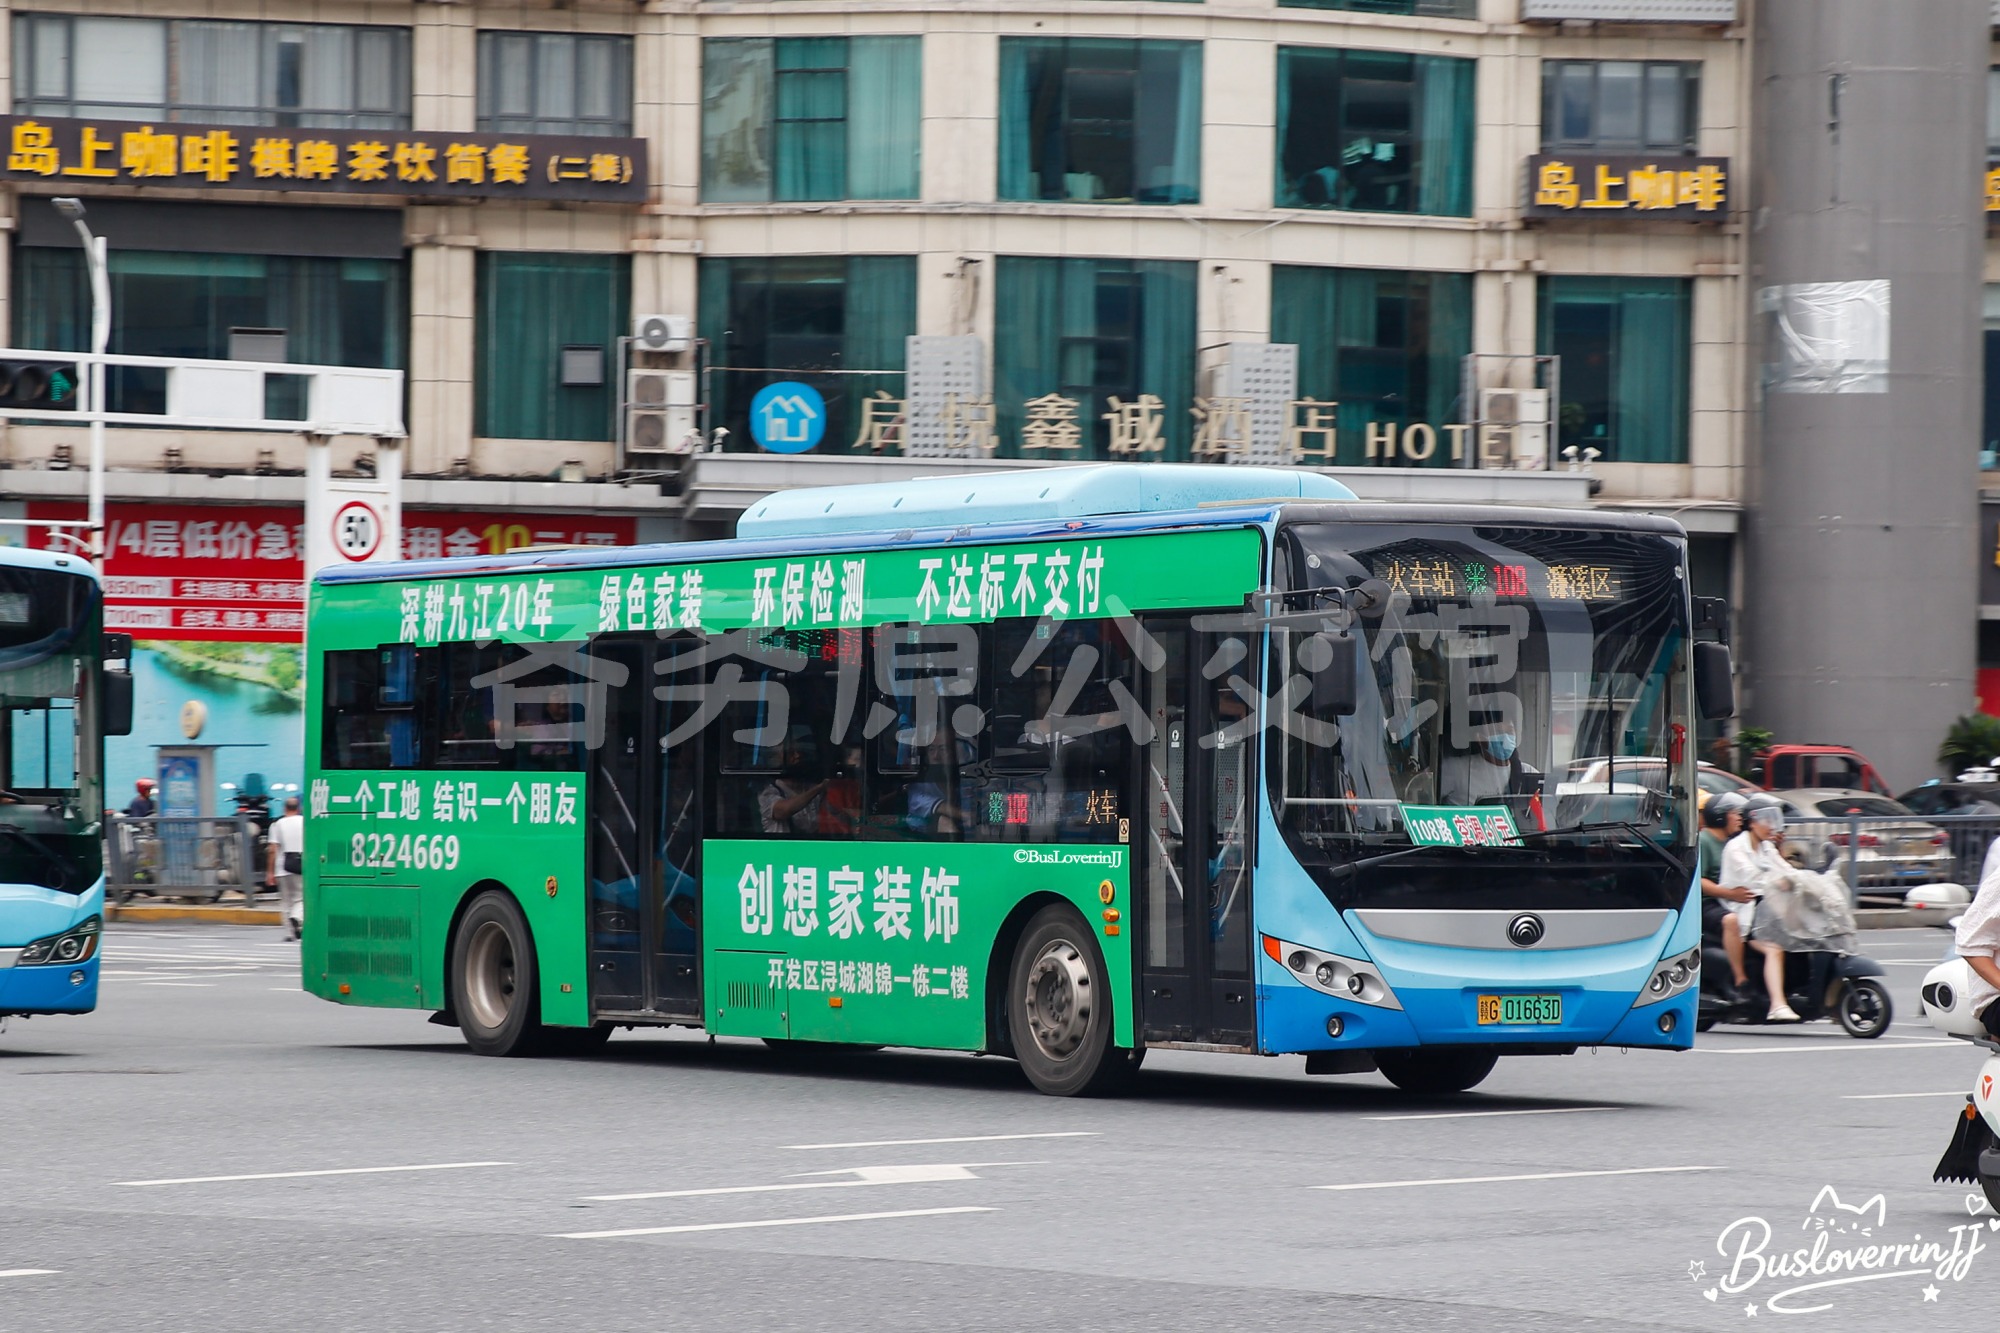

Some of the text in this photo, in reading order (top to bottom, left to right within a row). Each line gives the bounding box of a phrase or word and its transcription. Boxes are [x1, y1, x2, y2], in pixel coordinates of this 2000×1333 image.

[7, 120, 240, 183] 岛上咖啡
[1535, 161, 1726, 211] 岛上咖啡
[1365, 422, 1533, 464] HOTEL
[343, 515, 370, 548] 50
[399, 545, 1105, 642] 深耕九江20年 绿色家装 环保检测 不达标不交付
[1387, 561, 1456, 597] 火车站
[1493, 564, 1528, 597] 108
[310, 778, 578, 825] 做一个工地 结识一个朋友
[351, 832, 460, 871] 8224669
[1411, 817, 1456, 845] 108路
[737, 863, 960, 943] 创想家装饰
[767, 957, 969, 1000] 开发区浔城湖锦一栋二楼
[1505, 999, 1560, 1020] 01663D
